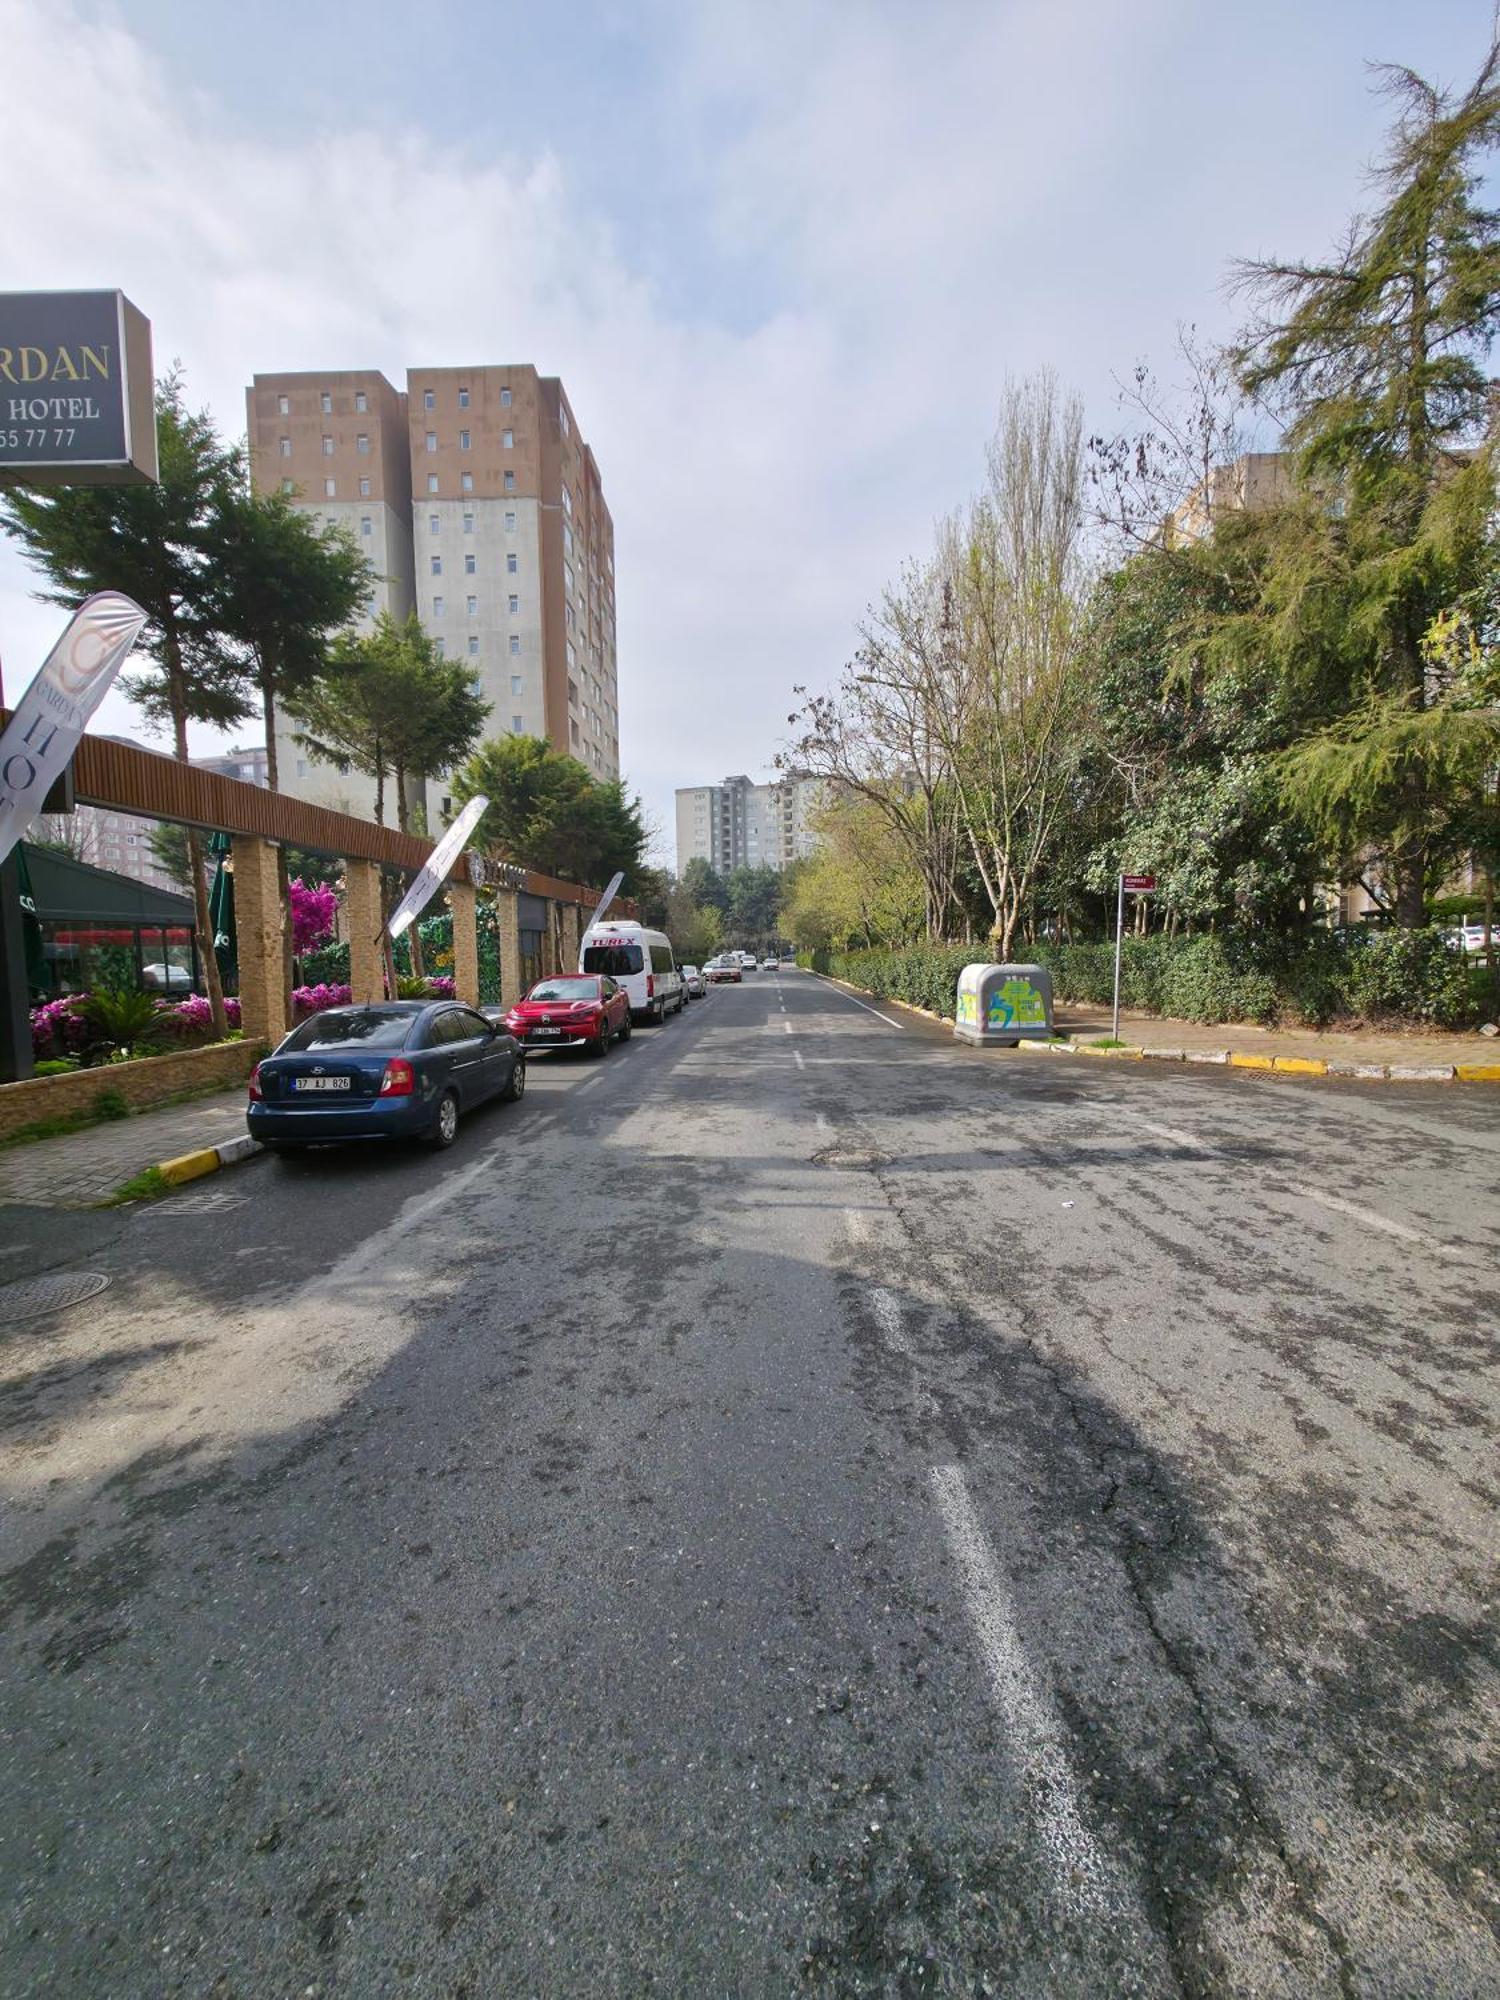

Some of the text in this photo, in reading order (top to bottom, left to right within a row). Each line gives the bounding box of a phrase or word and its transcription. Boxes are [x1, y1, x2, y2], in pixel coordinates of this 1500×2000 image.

[9, 398, 100, 420] HOTEL
[25, 429, 47, 447] 77
[54, 428, 76, 447] 77
[297, 1079, 307, 1088] 37
[333, 1078, 349, 1088] 826
